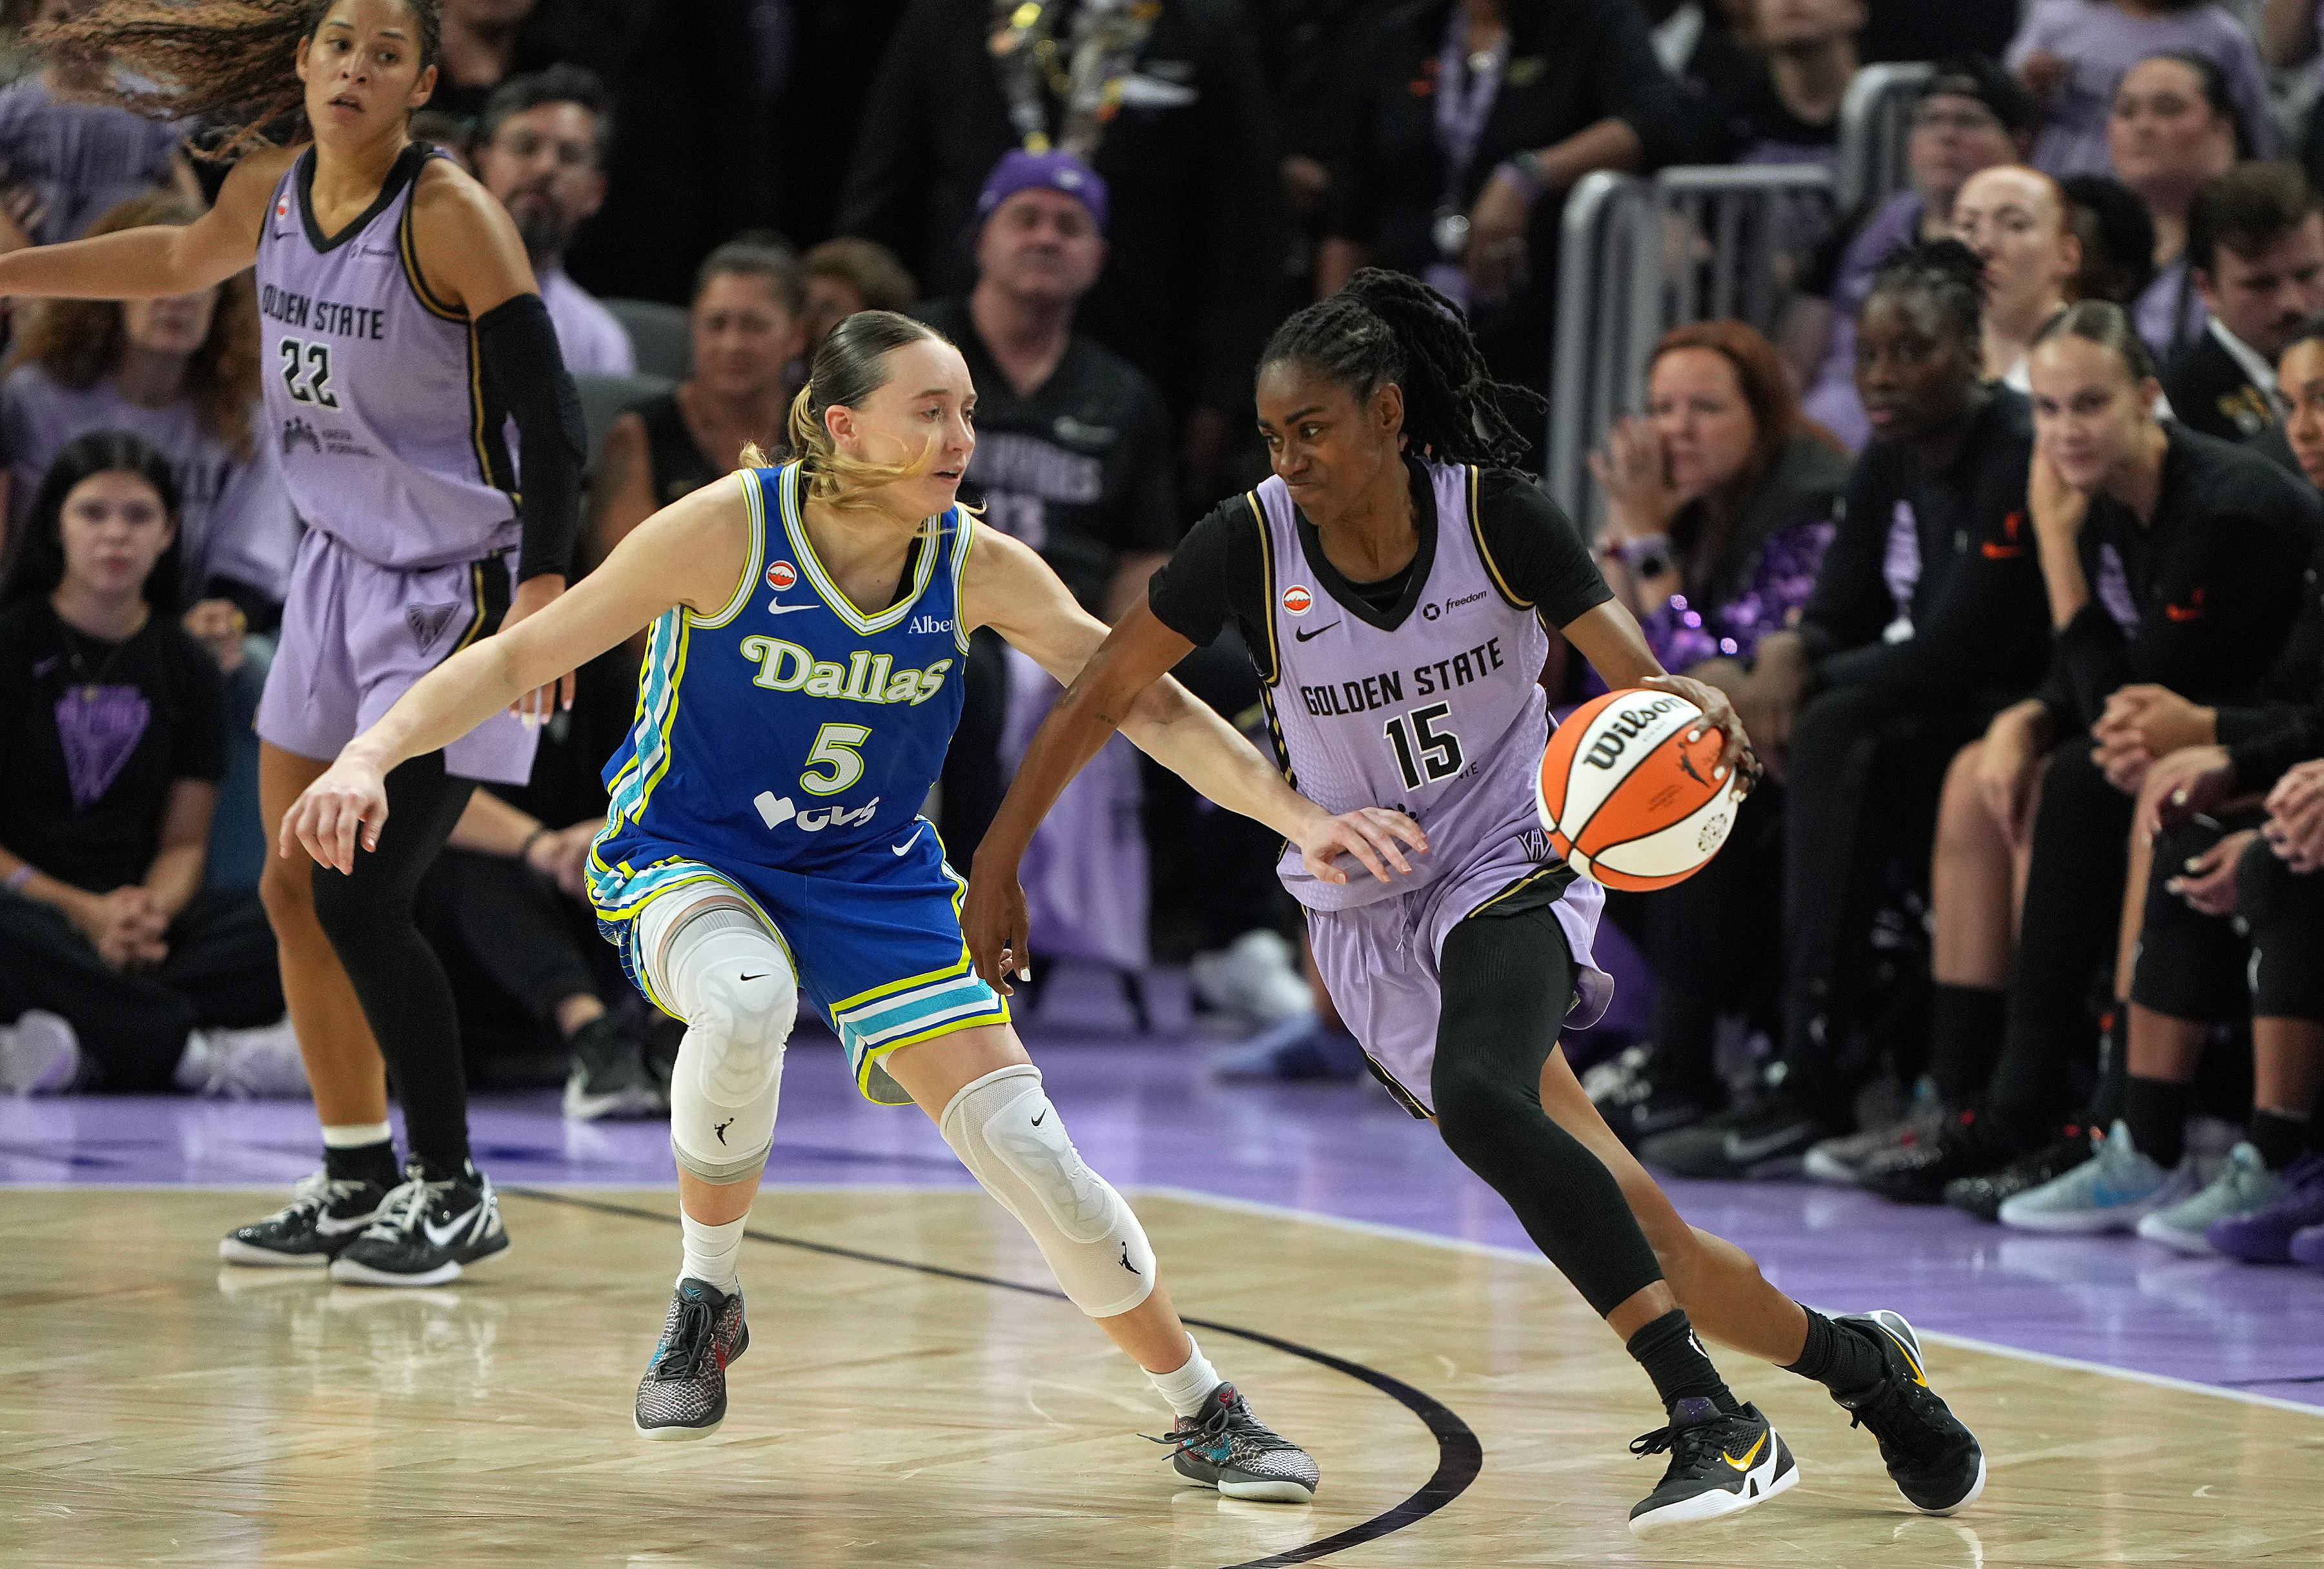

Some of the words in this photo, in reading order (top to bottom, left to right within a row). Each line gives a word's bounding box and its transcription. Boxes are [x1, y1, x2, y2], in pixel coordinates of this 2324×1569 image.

[263, 283, 311, 328] OLDEN
[314, 301, 384, 340] STATE
[278, 335, 341, 413] 22
[907, 615, 953, 635] Alber
[1445, 590, 1487, 615] freedom
[740, 634, 953, 706] Dallas
[1300, 670, 1404, 717] GOLDEN
[1413, 636, 1505, 697] STATE
[799, 723, 873, 797] 5
[1383, 699, 1465, 793] 15
[1582, 697, 1689, 771] Wilson
[796, 795, 880, 832] CVS
